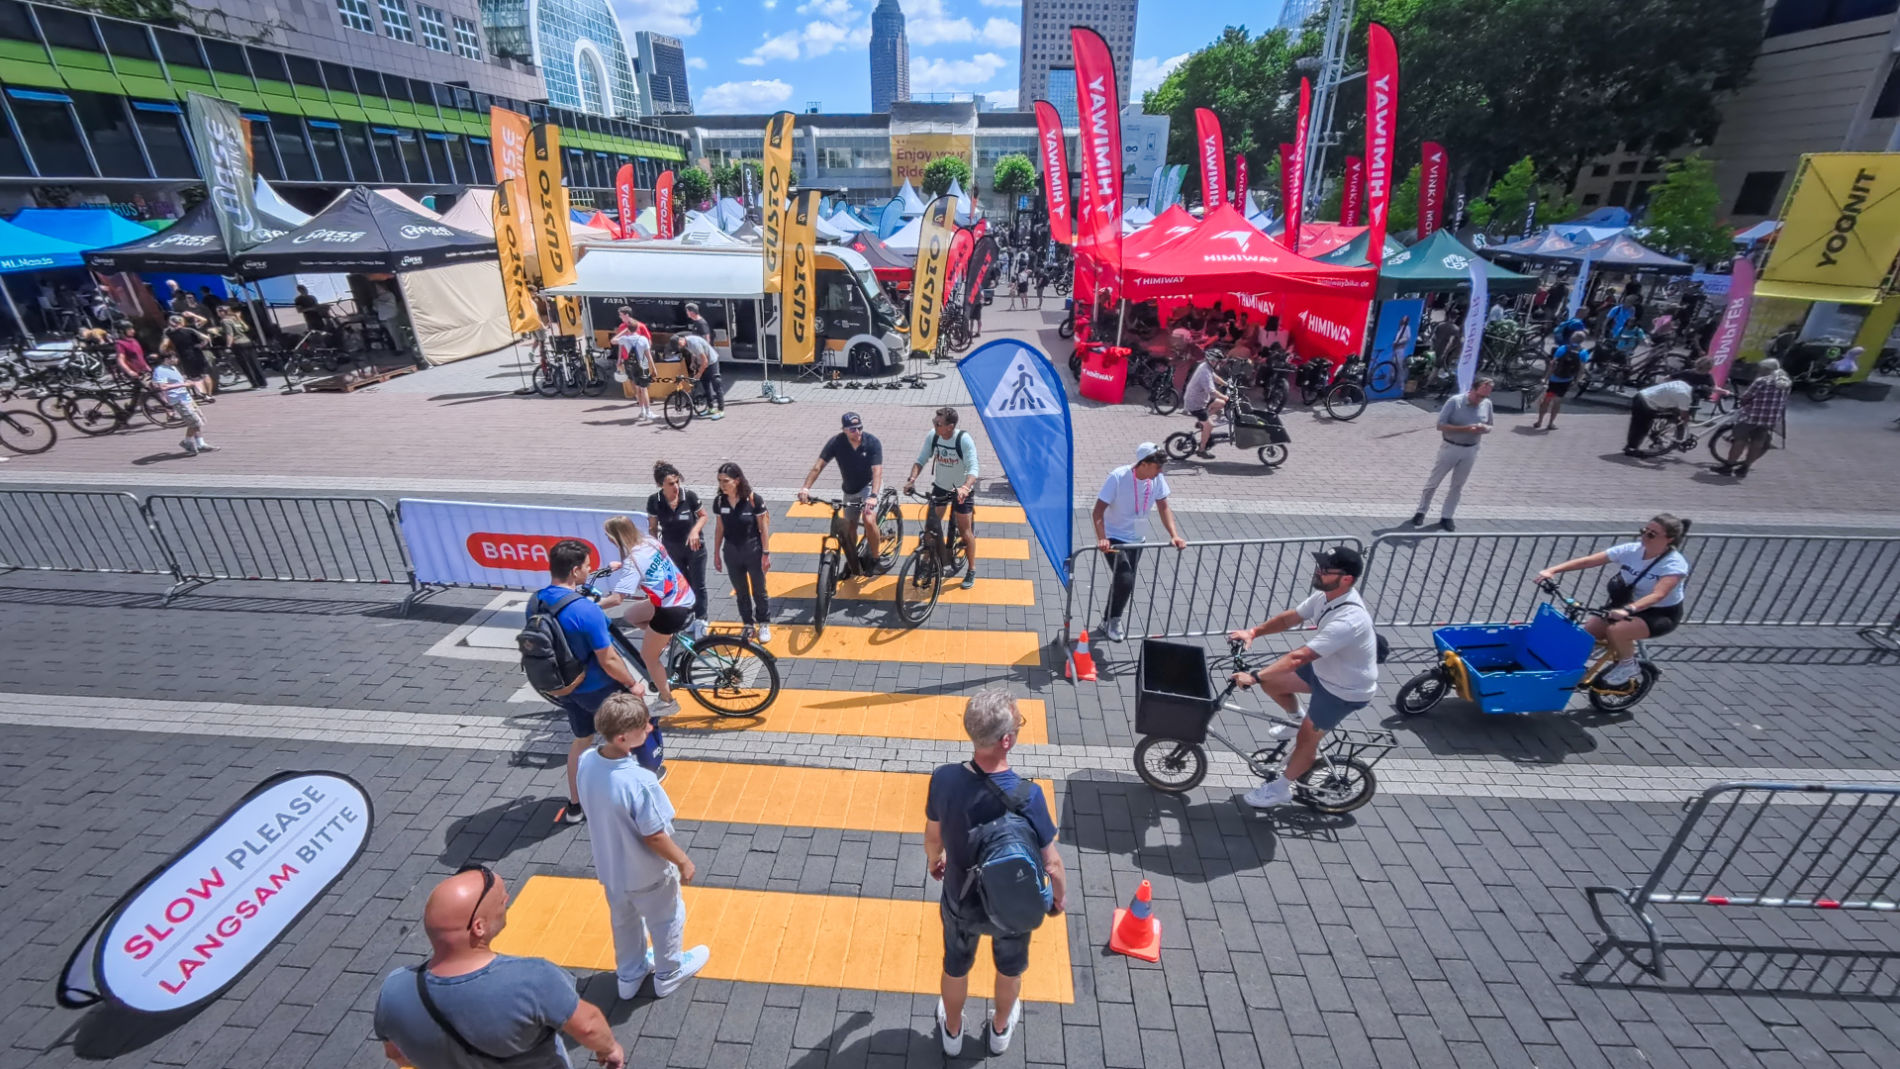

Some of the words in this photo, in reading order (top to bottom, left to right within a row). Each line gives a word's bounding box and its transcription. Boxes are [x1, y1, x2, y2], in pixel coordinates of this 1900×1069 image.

[501, 125, 516, 181] ASE
[896, 147, 932, 163] Enjoy
[897, 166, 925, 178] Ride
[538, 169, 564, 273] GUSTO
[621, 183, 633, 239] RTOPIA
[767, 166, 781, 273] GUSTO
[1816, 168, 1876, 268] YOONIT
[793, 242, 807, 344] GUSTO
[919, 234, 941, 338] GUSTO
[1142, 276, 1185, 285] HIMIWAY
[1203, 254, 1279, 264] HIMIWAY
[481, 542, 550, 563] BAFA
[123, 867, 226, 960] SLOW
[224, 785, 326, 870] PLEASE
[158, 862, 300, 995] LANGSAM
[295, 806, 359, 864] BITTE
